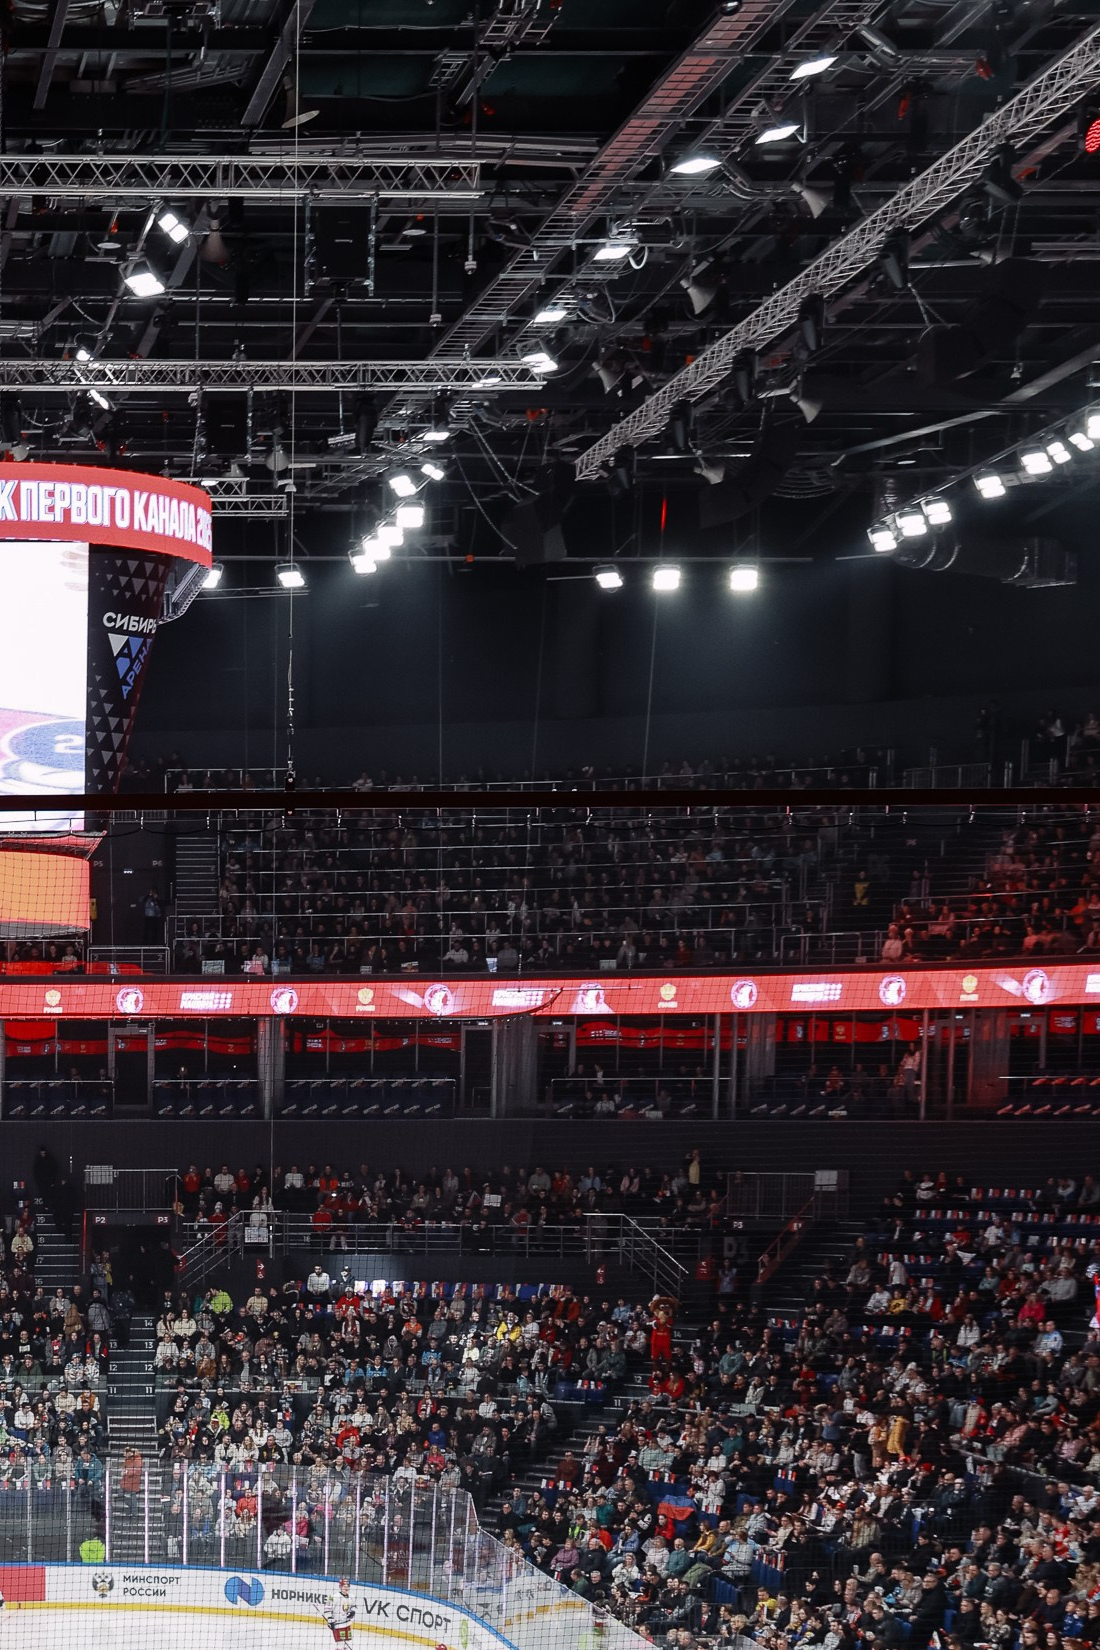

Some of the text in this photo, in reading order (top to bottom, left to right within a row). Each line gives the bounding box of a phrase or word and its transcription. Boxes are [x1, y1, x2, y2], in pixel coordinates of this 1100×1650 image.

[19, 481, 130, 529] ПЕРВОГО
[133, 490, 196, 541] КАНАЛА
[103, 611, 158, 634] СИБИРЬ
[109, 1341, 118, 1350] 13
[144, 1341, 154, 1350] 13
[109, 1364, 118, 1372] 12
[144, 1364, 154, 1372] 12
[110, 1386, 118, 1394] 11
[145, 1386, 154, 1394] 11
[123, 1576, 181, 1586] МИНСПОРТ
[123, 1588, 166, 1598] РОССИИ
[363, 1598, 452, 1634] VK СПОРТ
